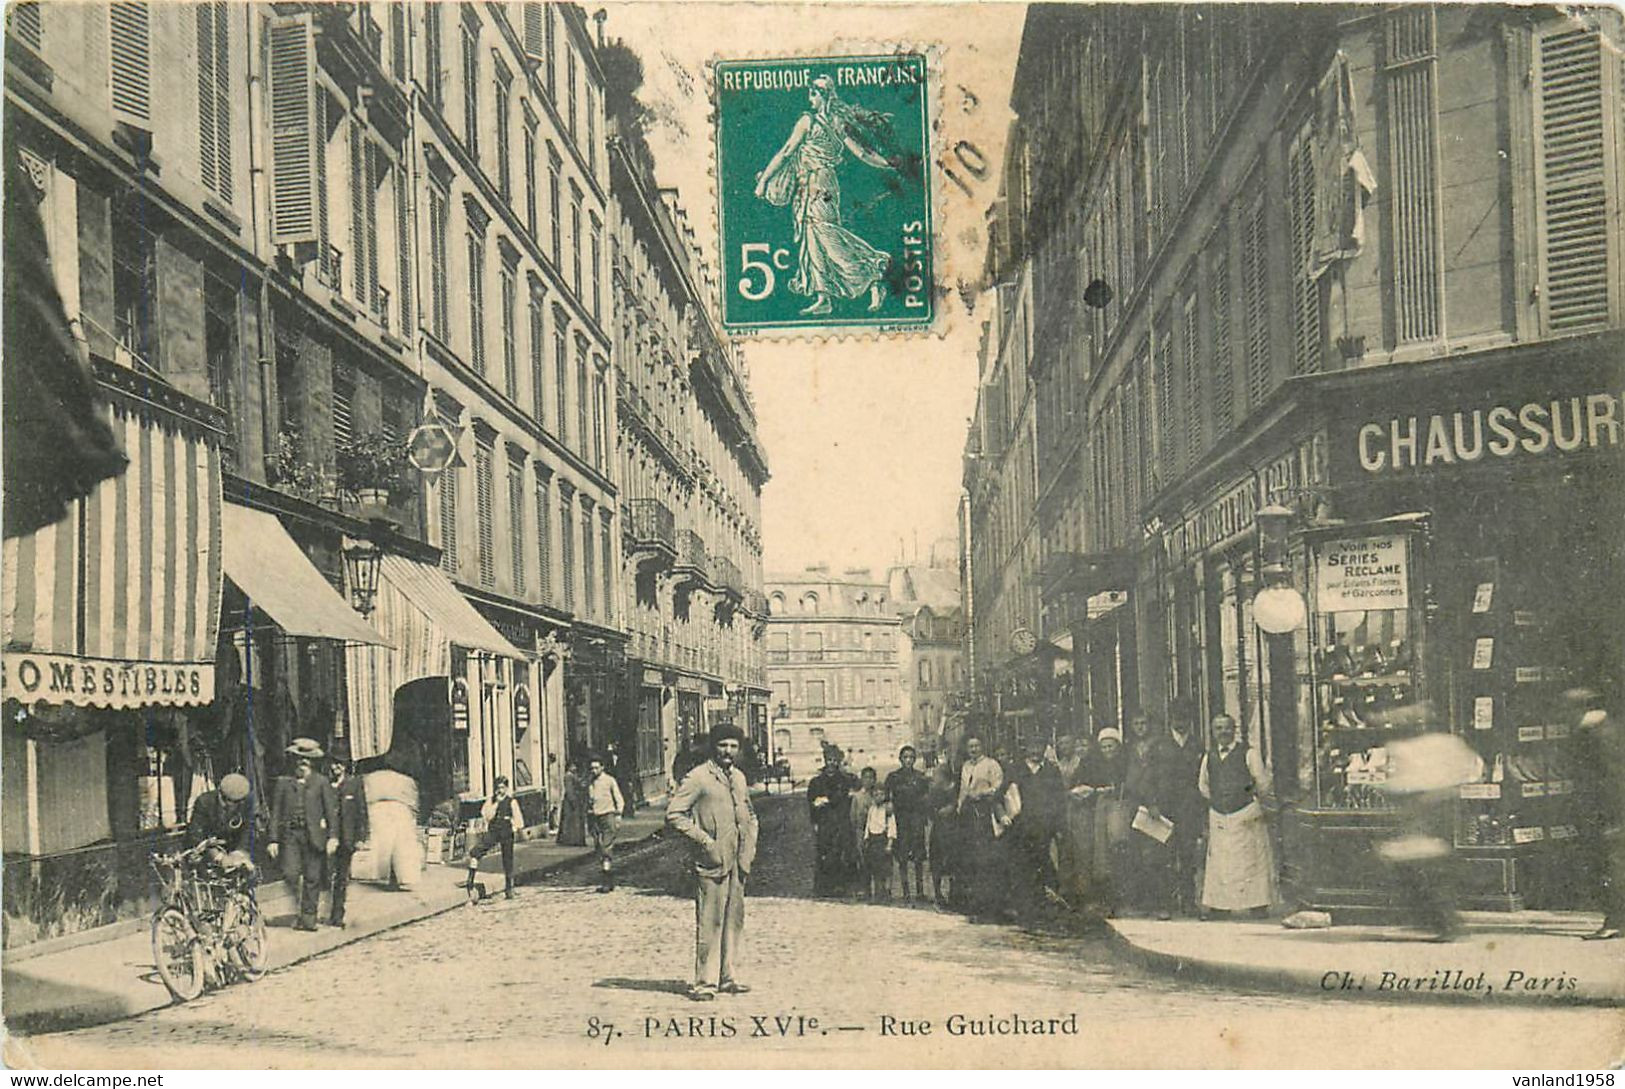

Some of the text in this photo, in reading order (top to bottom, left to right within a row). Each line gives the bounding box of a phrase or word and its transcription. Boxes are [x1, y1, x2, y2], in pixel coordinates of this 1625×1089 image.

[837, 65, 917, 87] FRANÇAISE
[903, 220, 924, 308] POSTES
[1358, 391, 1625, 472] CHAUSSUR
